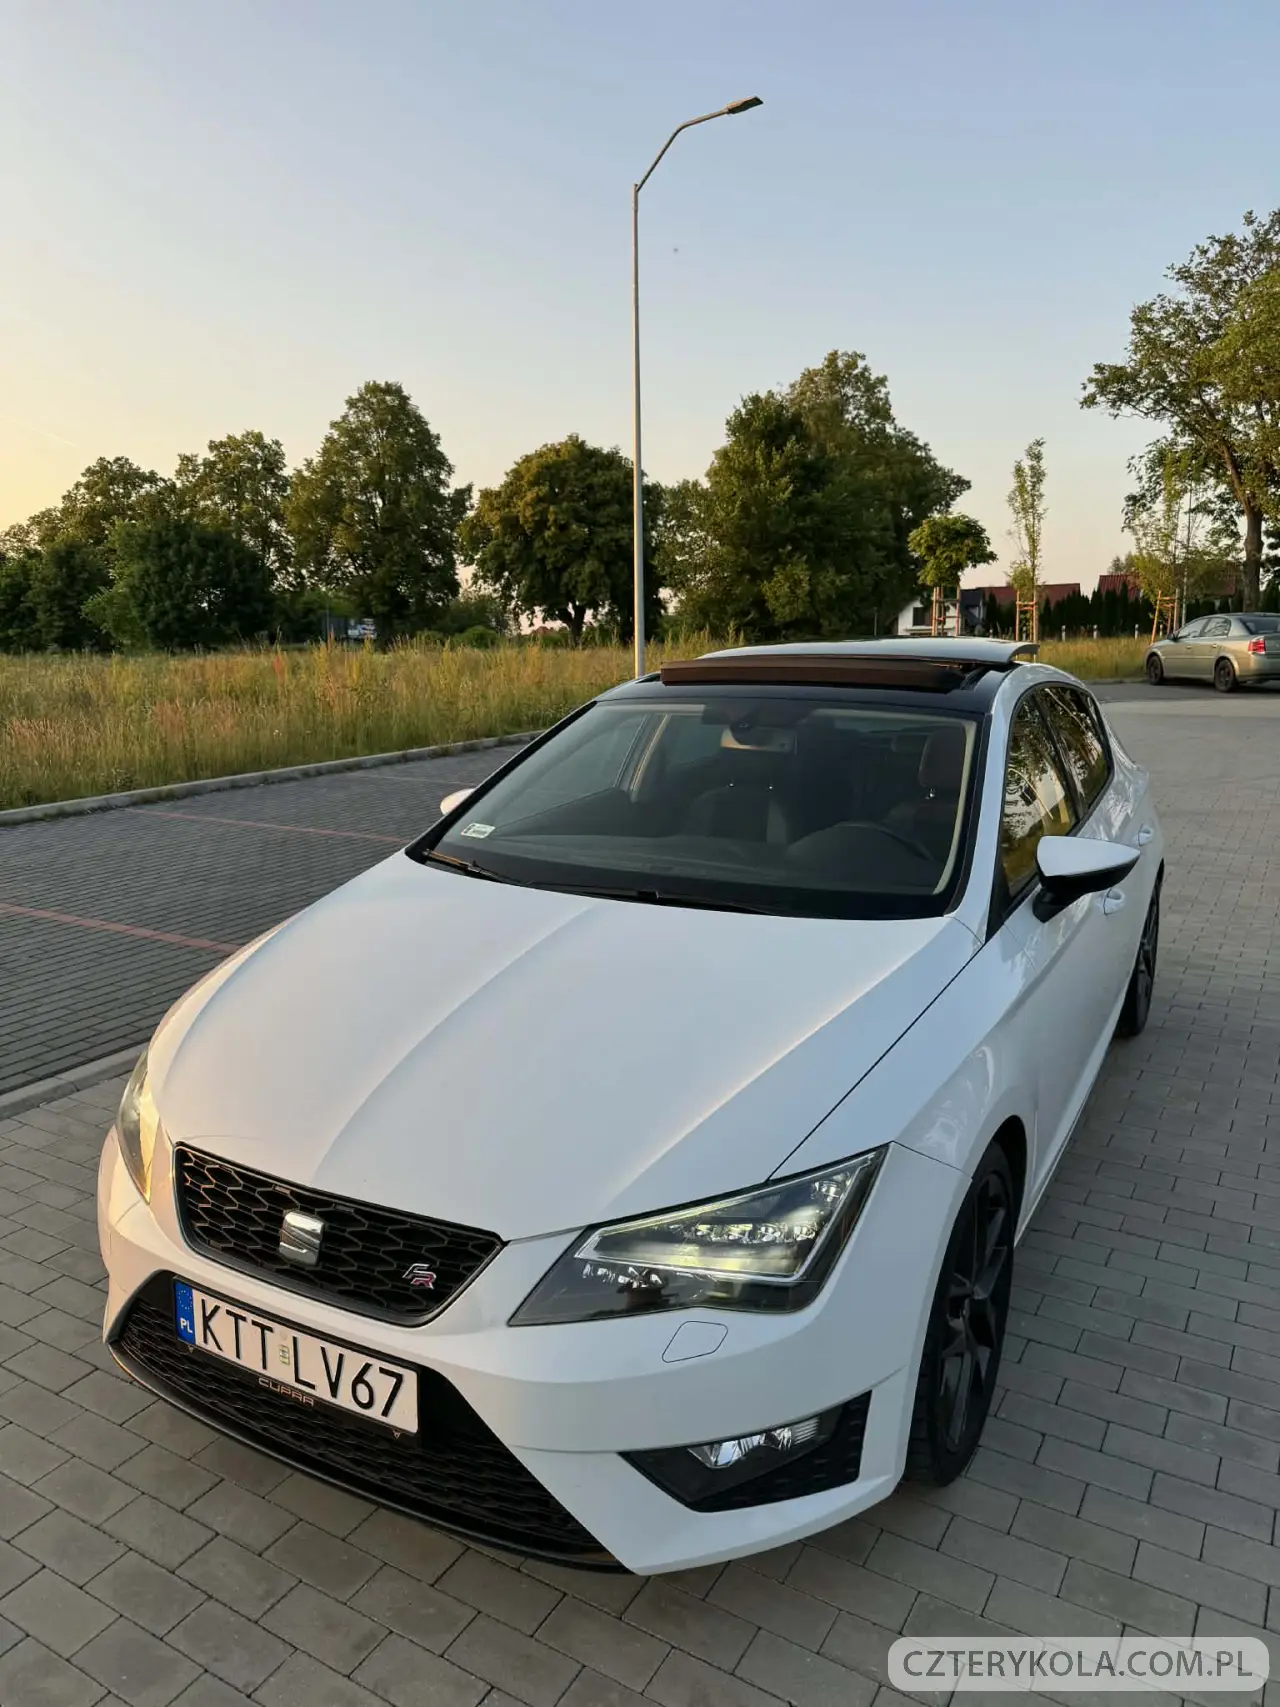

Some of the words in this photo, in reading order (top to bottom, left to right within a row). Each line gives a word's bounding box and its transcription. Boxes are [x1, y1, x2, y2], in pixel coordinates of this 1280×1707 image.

[179, 1316, 193, 1333] PL
[200, 1298, 273, 1370] KTT
[292, 1336, 404, 1418] LV67
[258, 1377, 314, 1407] CUPRA
